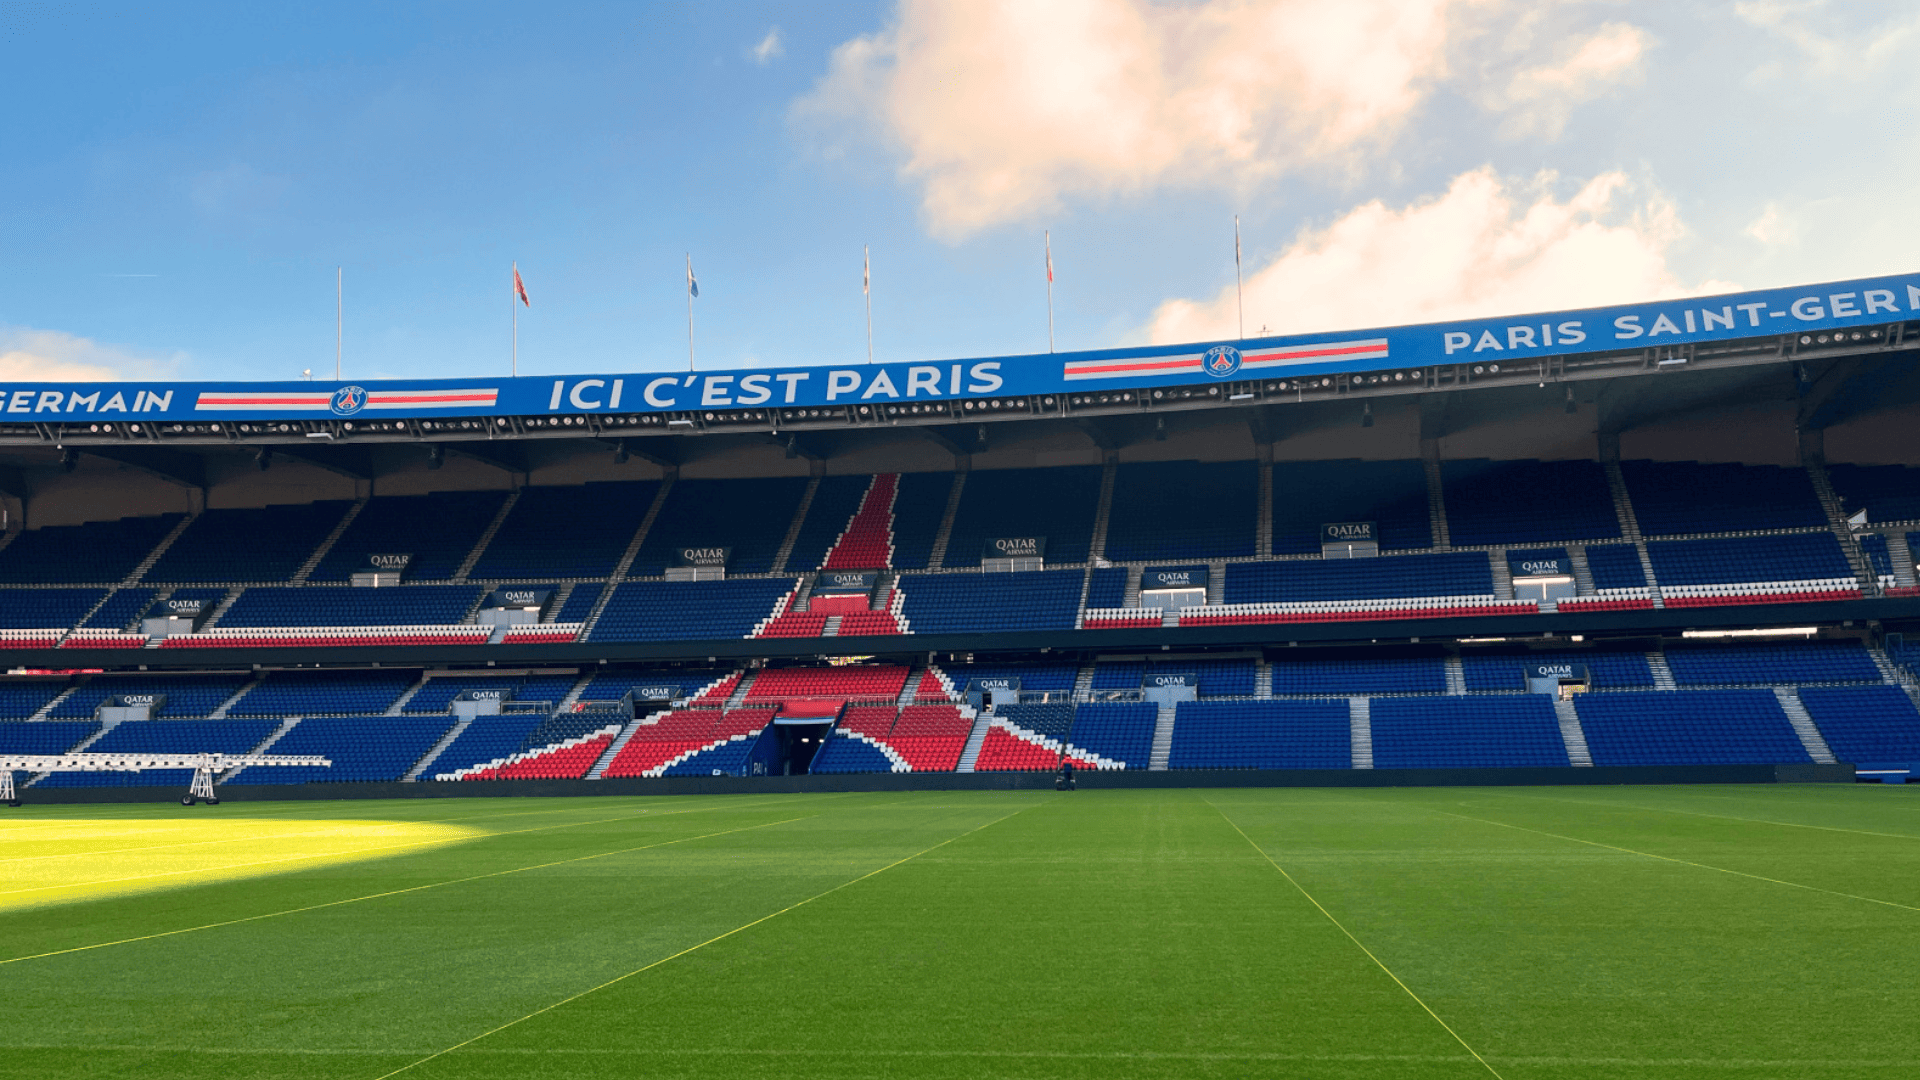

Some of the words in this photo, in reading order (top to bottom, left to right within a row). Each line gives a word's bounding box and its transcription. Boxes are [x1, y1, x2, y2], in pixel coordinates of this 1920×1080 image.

[1444, 320, 1587, 355] PARIS
[549, 379, 624, 410] ICI
[643, 371, 811, 408] C'EST
[826, 361, 1003, 402] PARIS
[0, 390, 174, 413] ERMAIN
[1327, 524, 1370, 537] QATAR
[996, 539, 1035, 551] QATAR
[684, 549, 724, 560] QATAR
[370, 555, 408, 567] QATAR
[1522, 561, 1558, 572] QATAR
[834, 574, 863, 583] QATAR
[1157, 573, 1190, 582] QATAR
[505, 591, 535, 601] QATAR
[168, 600, 200, 609] QATAR
[1538, 665, 1571, 676] QATAR
[981, 680, 1009, 690] QATAR
[1155, 677, 1185, 686] QATAR
[472, 691, 500, 700] QATAR
[641, 688, 670, 697] QATAR
[123, 695, 153, 704] QATAR
